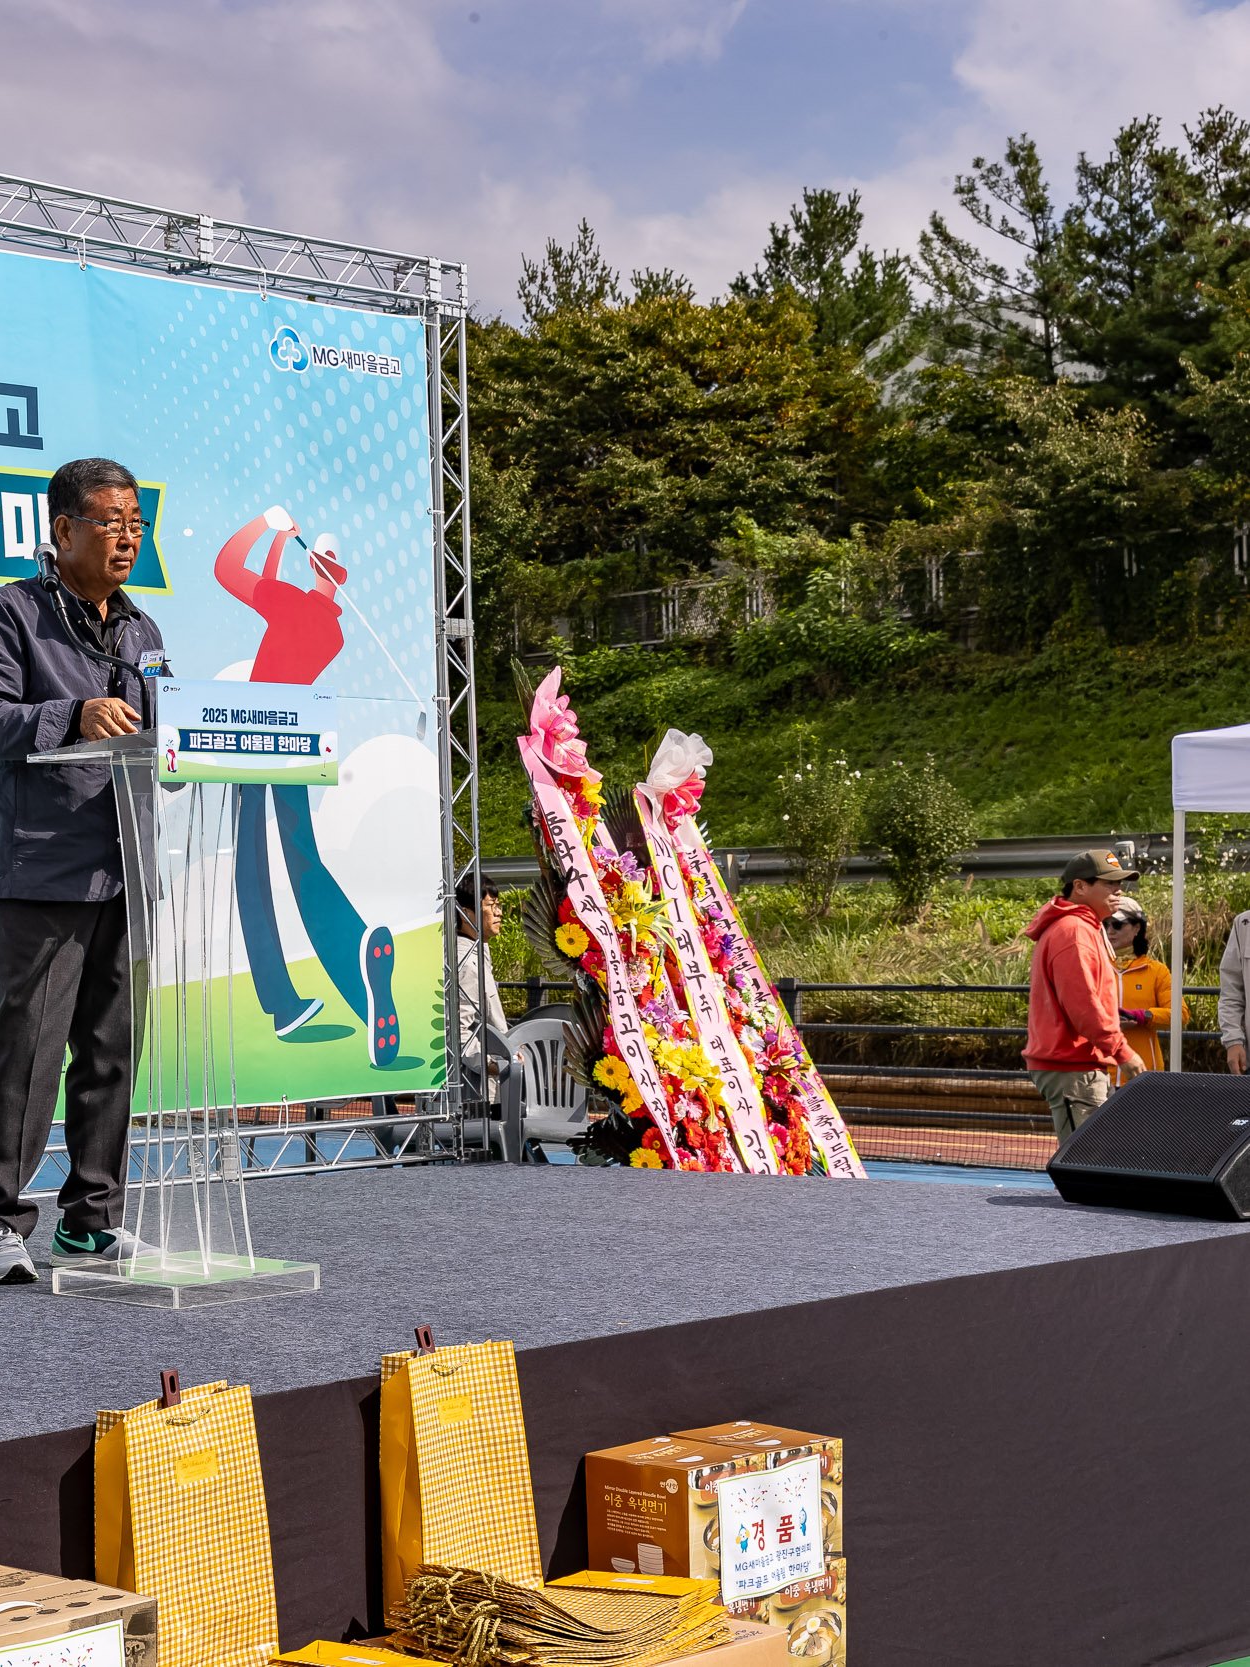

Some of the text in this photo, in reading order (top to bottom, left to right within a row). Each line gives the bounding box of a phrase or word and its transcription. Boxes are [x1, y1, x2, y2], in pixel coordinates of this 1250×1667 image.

[313, 347, 401, 375] MG새마을금고
[202, 707, 299, 727] 2025 MG새마을금고
[189, 733, 312, 753] 파크골프 어울림 한마당
[710, 1035, 754, 1117] 대표이사
[604, 1492, 667, 1516] 이중 옥냉면기
[735, 1553, 774, 1573] MG새마을금고
[784, 1576, 832, 1598] 이중 옥냉면기
